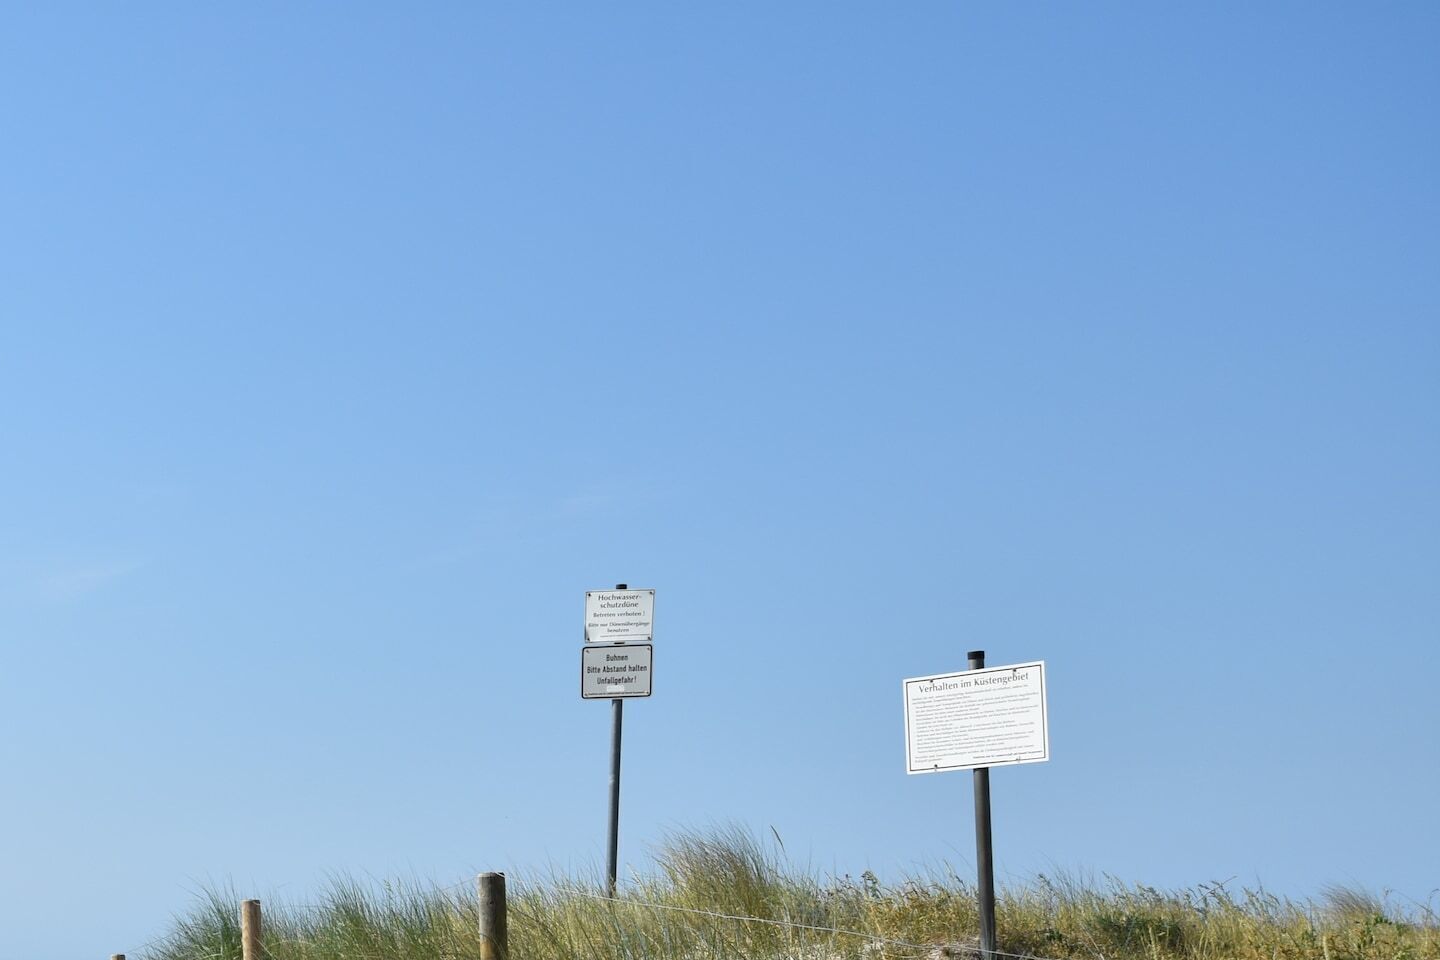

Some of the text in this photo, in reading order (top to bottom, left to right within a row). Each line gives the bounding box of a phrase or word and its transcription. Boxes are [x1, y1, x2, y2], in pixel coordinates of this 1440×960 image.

[918, 672, 1029, 693] Verhalten im Küstengebiet
